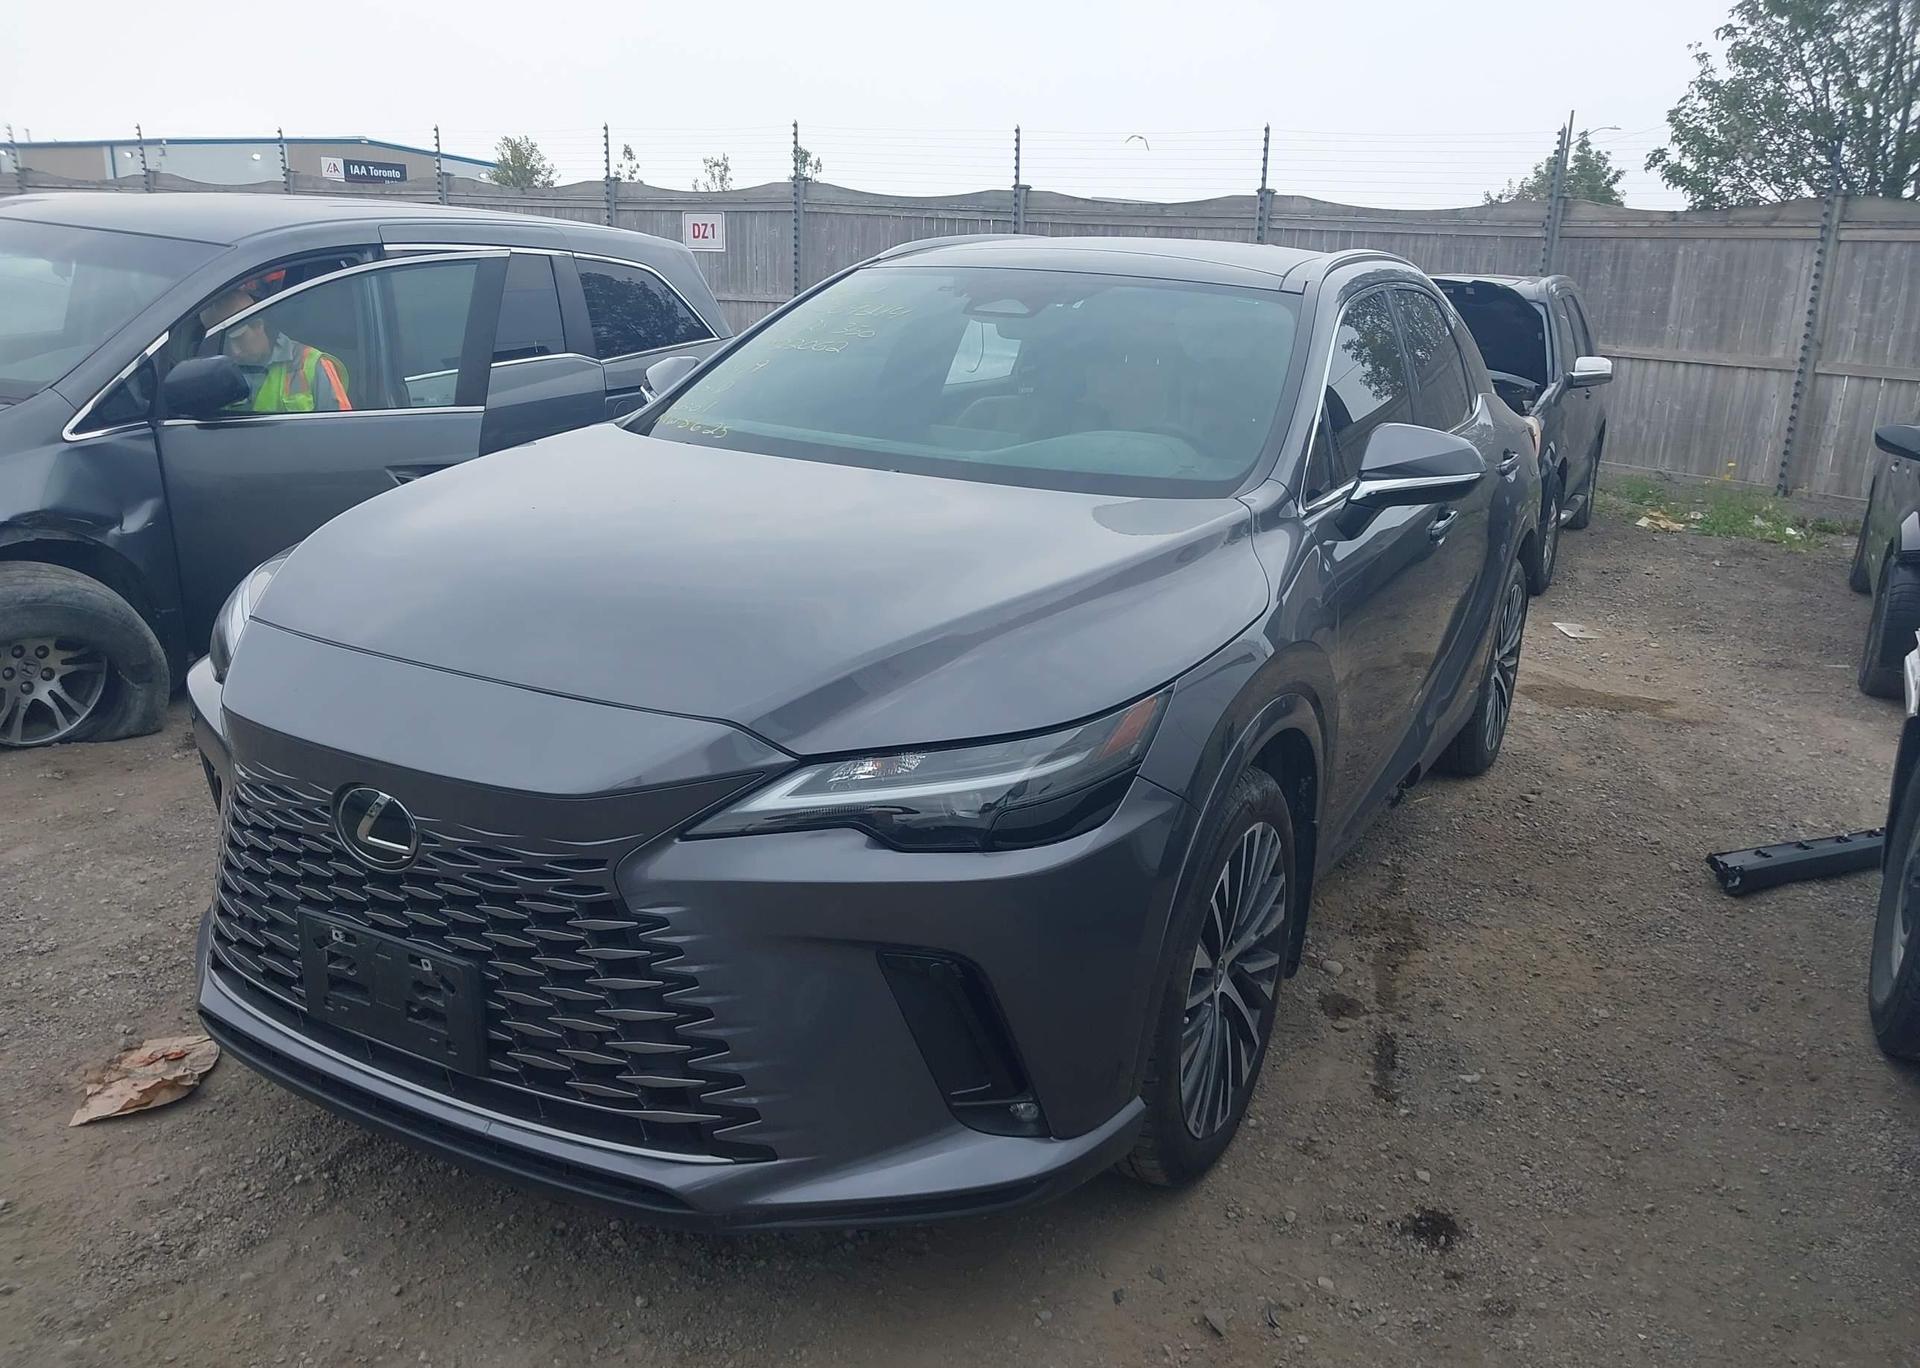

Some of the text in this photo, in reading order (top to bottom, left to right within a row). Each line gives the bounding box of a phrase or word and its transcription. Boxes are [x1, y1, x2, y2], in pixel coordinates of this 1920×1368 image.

[350, 164, 401, 178] IAA Toronto
[692, 223, 715, 239] DZ1
